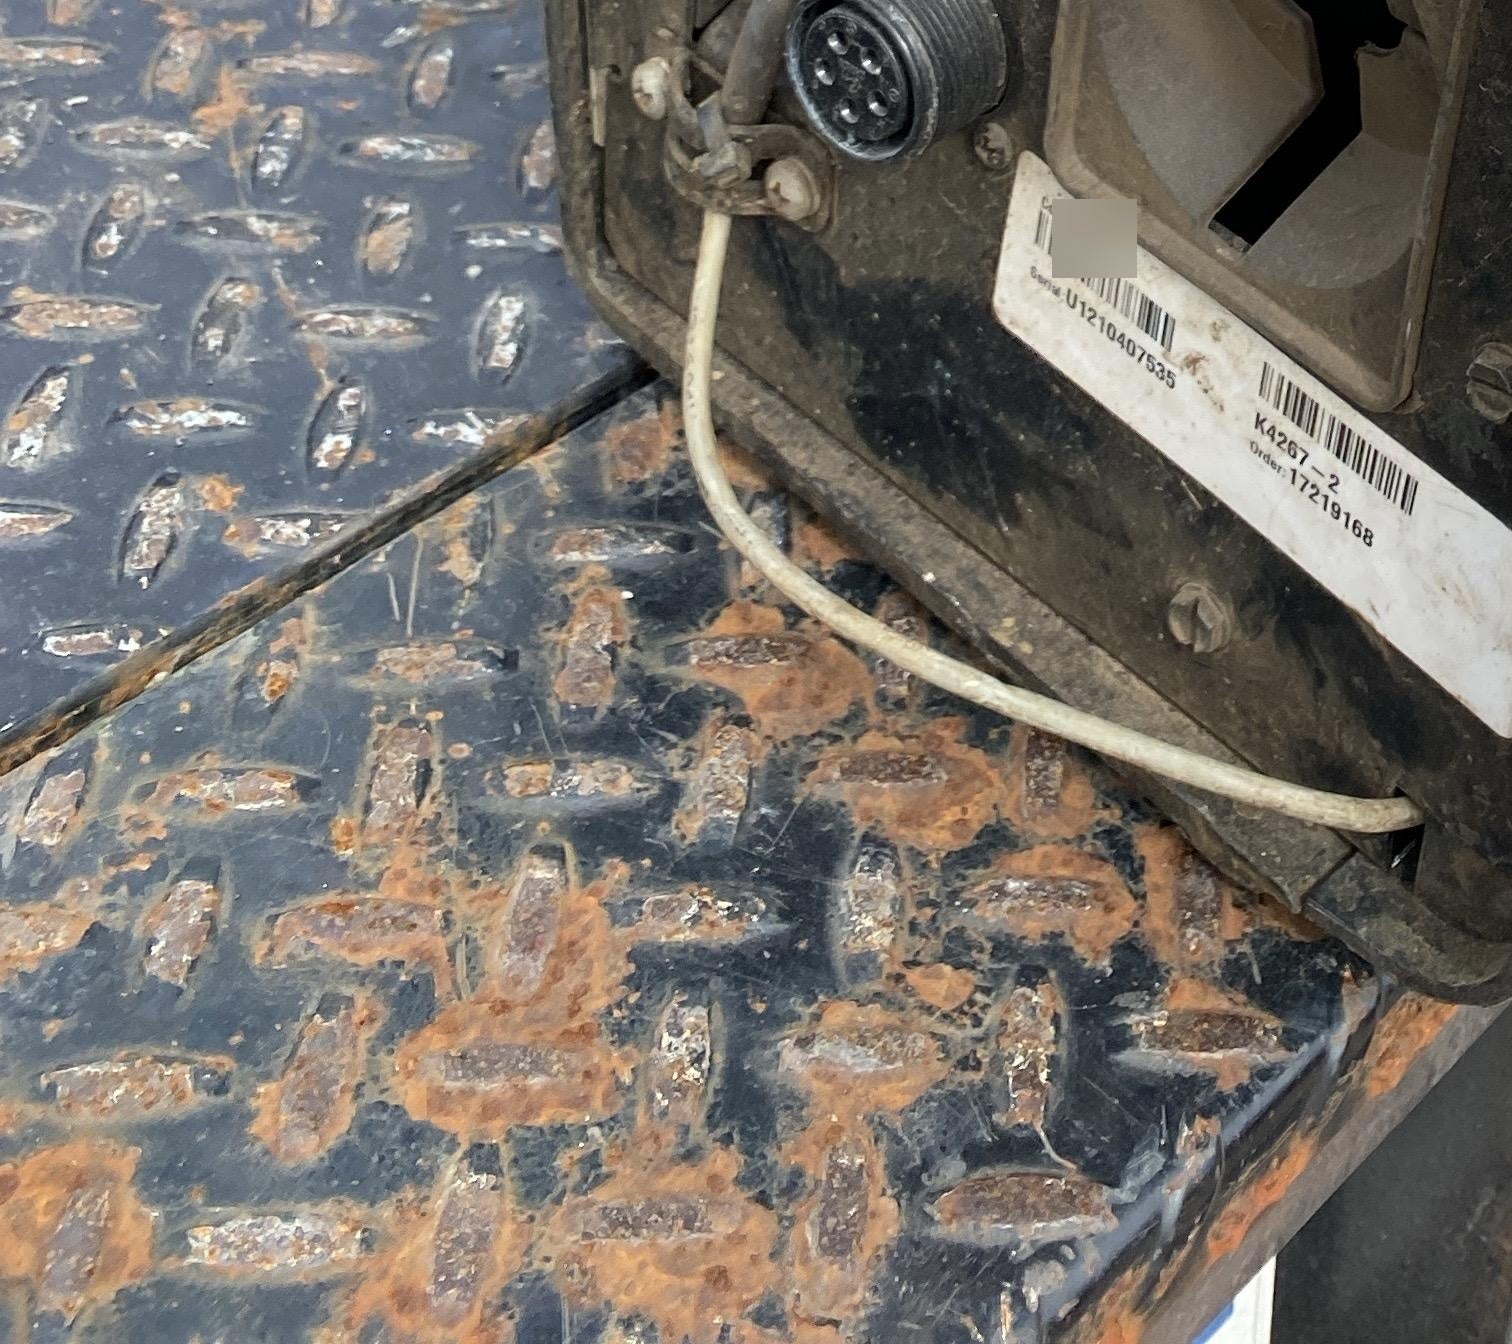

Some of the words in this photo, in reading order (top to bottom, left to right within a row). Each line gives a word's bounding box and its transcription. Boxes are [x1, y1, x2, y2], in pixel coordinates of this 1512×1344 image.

[1066, 287, 1177, 390] U1210407535
[1250, 440, 1287, 478] Order:
[1290, 467, 1375, 548] 17219168
